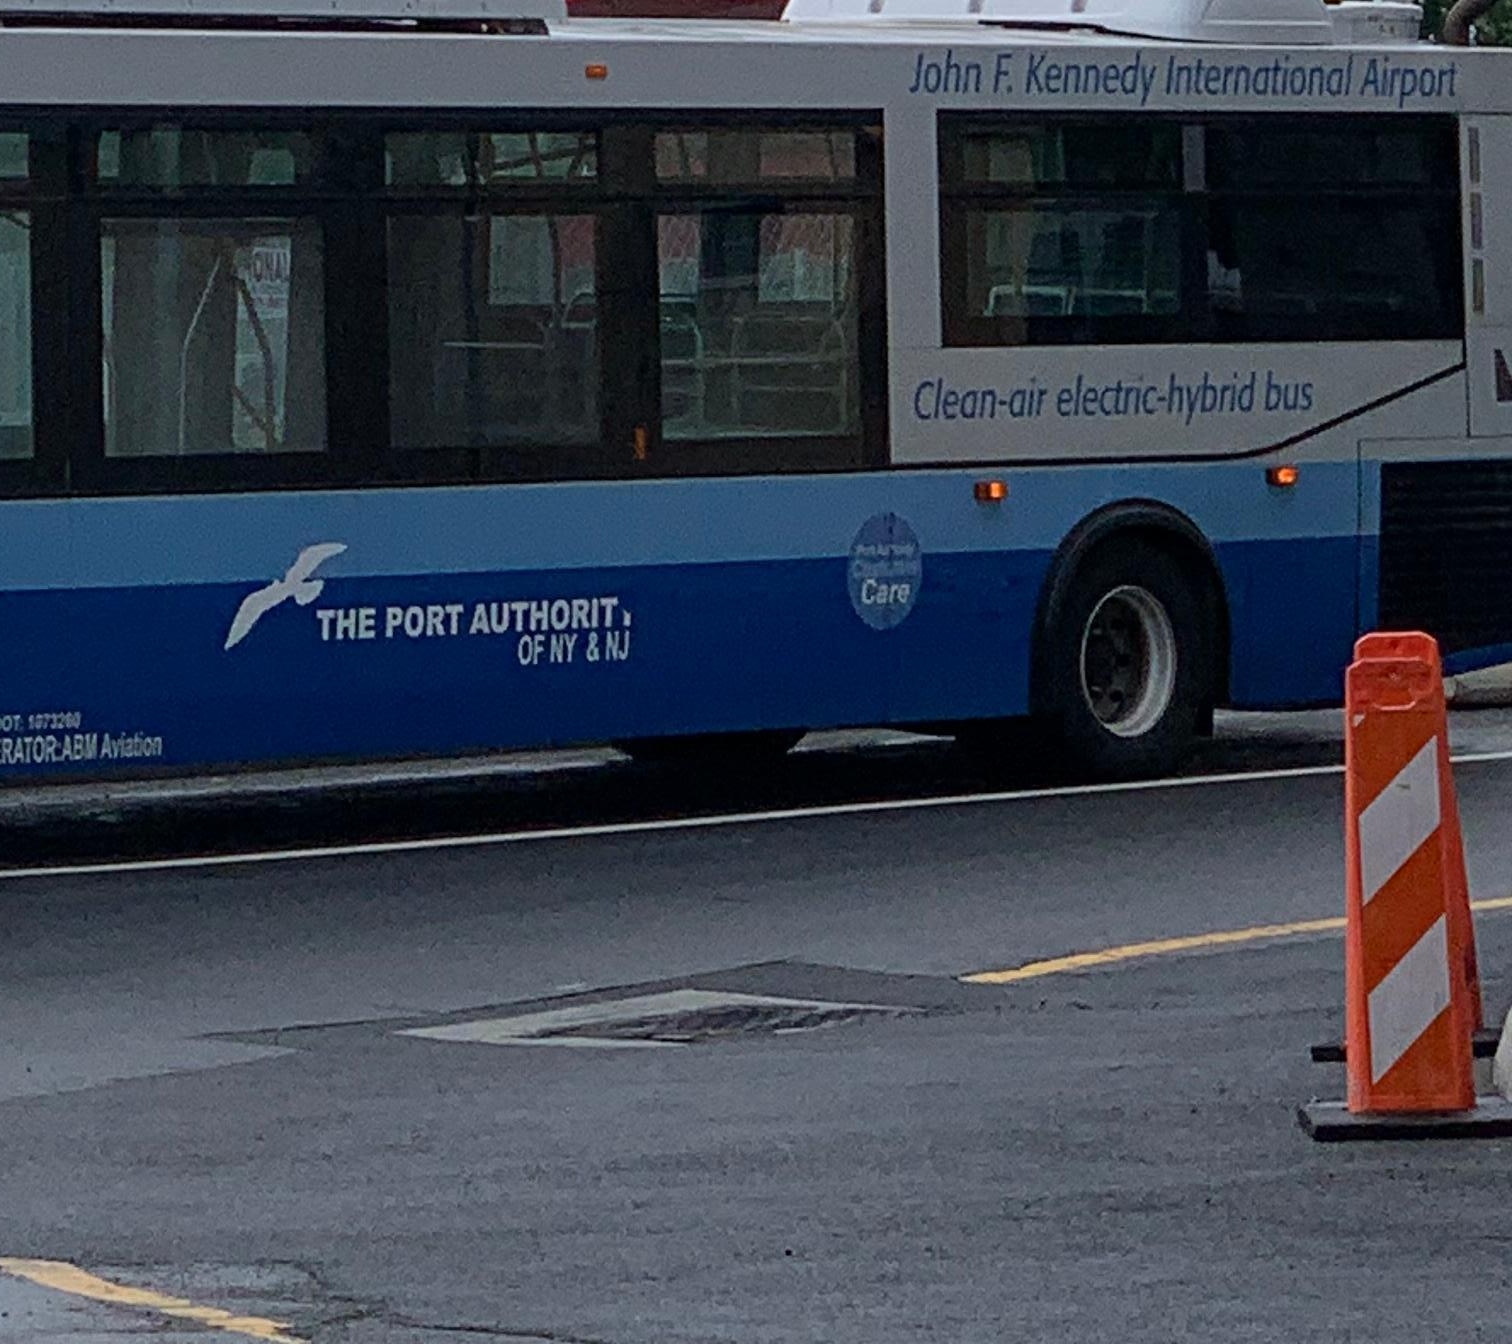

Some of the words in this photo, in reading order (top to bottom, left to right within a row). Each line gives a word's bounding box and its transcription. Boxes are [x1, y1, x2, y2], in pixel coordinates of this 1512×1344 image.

[909, 50, 982, 94] John
[993, 53, 1013, 94] F.
[1025, 49, 1156, 106] Kennedy
[1165, 54, 1354, 96] International
[1359, 56, 1457, 109] Airport
[913, 377, 1047, 421] Clean-air
[1056, 371, 1256, 425] electric-hybrid
[1264, 370, 1314, 411] bus
[862, 579, 910, 604] Care
[316, 607, 376, 640] THE
[385, 604, 464, 637] PORT
[518, 635, 545, 665] OF
[549, 633, 578, 663] NY
[586, 631, 600, 662] &
[605, 630, 631, 661] NJ
[100, 732, 163, 759] Aviation
